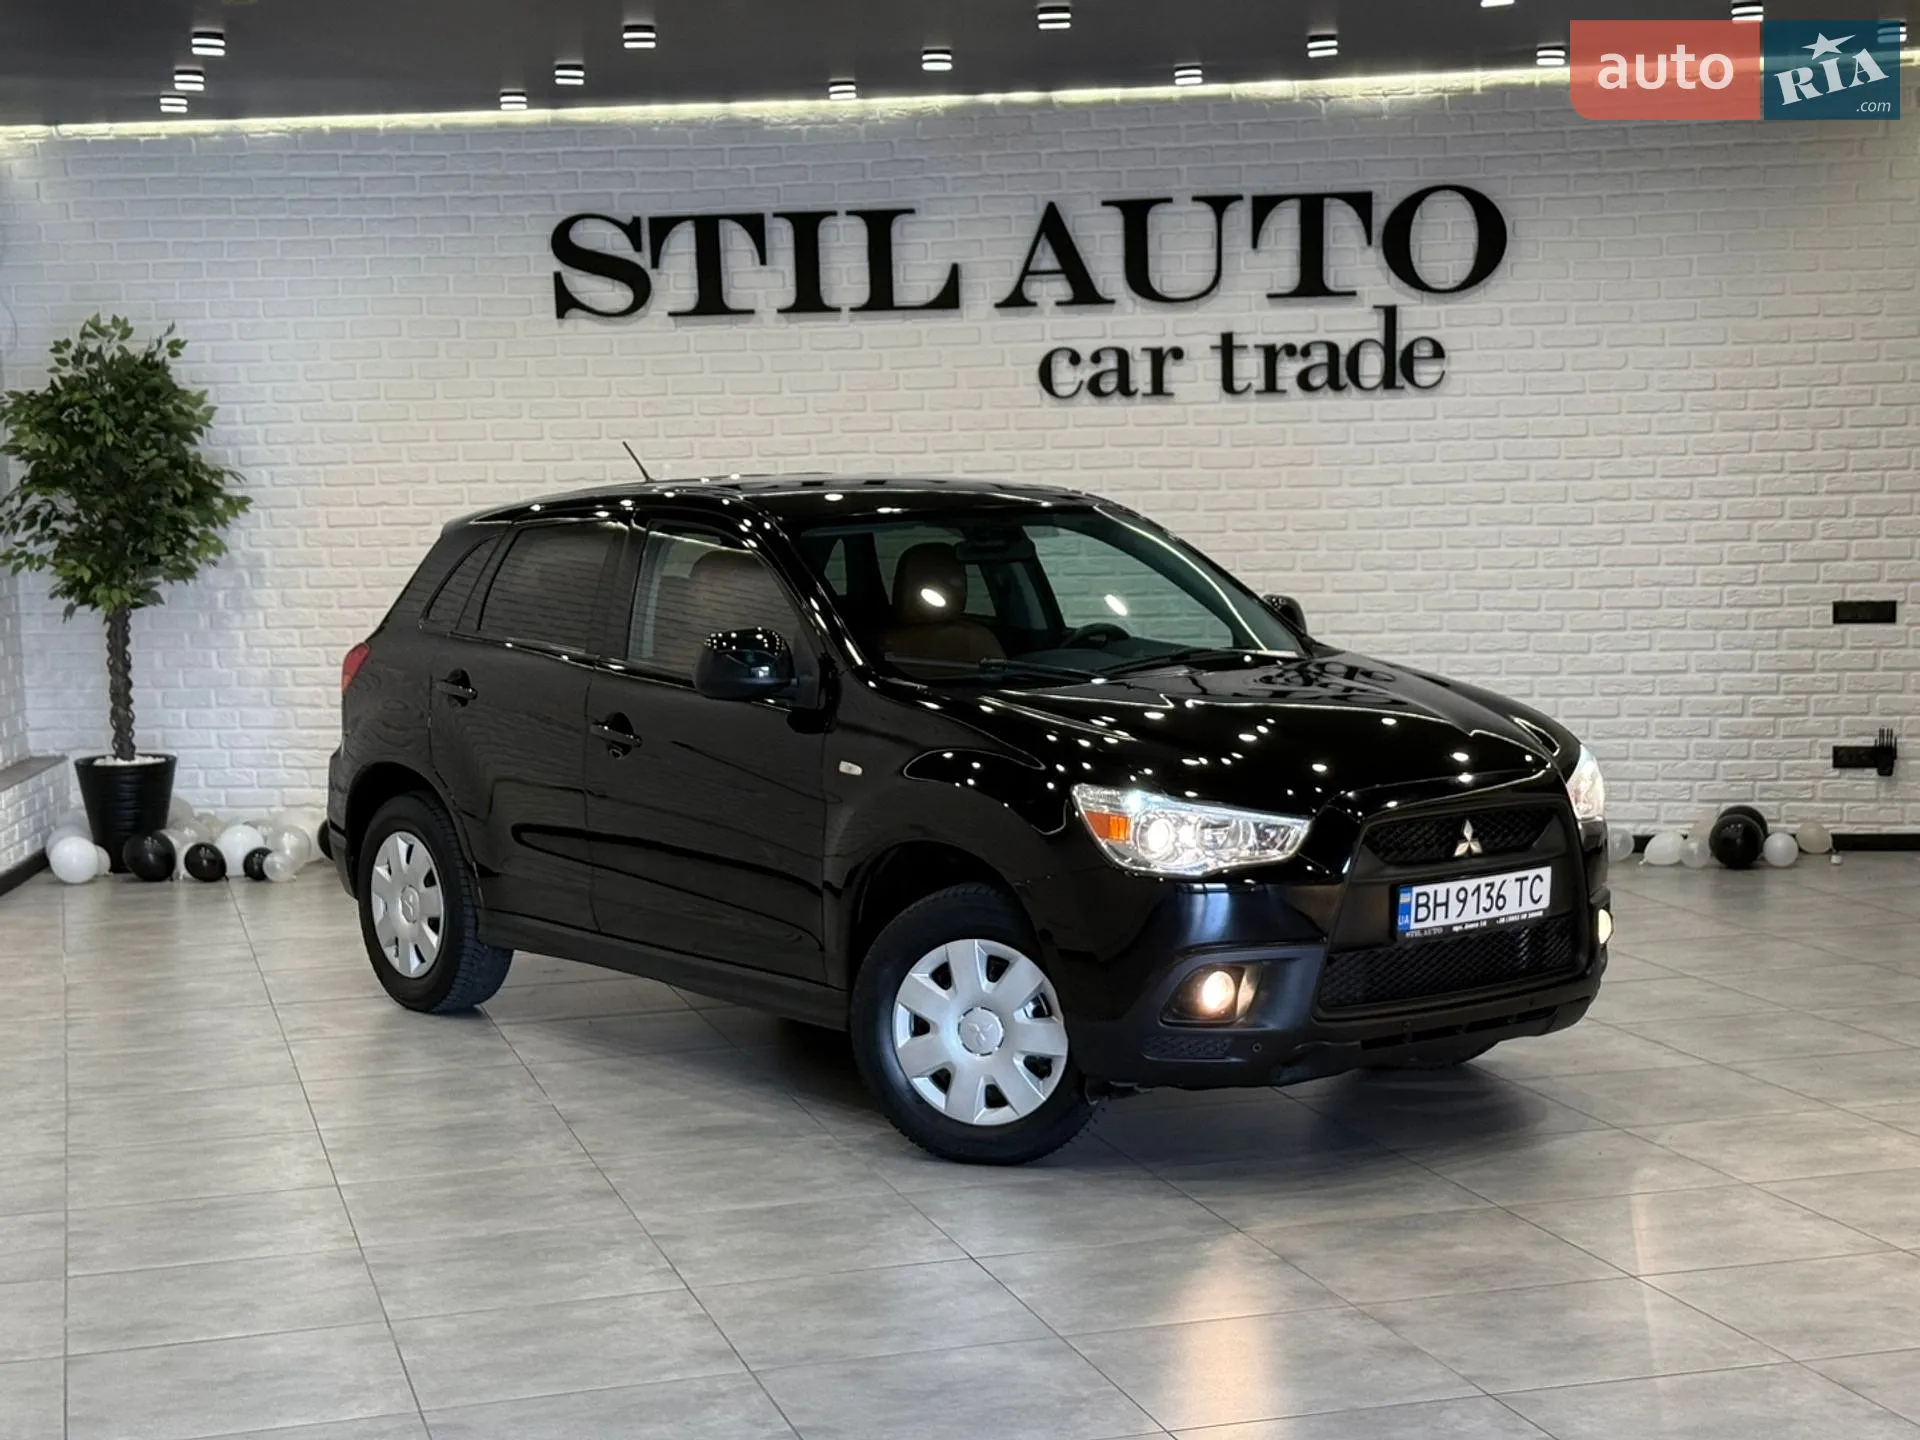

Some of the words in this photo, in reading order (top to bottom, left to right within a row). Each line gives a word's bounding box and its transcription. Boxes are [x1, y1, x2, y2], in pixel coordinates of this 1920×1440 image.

[551, 208, 960, 319] STIL
[994, 184, 1507, 310] AUTO
[1038, 346, 1184, 398] car
[1211, 305, 1445, 395] trade
[1414, 888, 1450, 923] BH
[1456, 879, 1507, 918] 9136
[1514, 874, 1544, 908] TC
